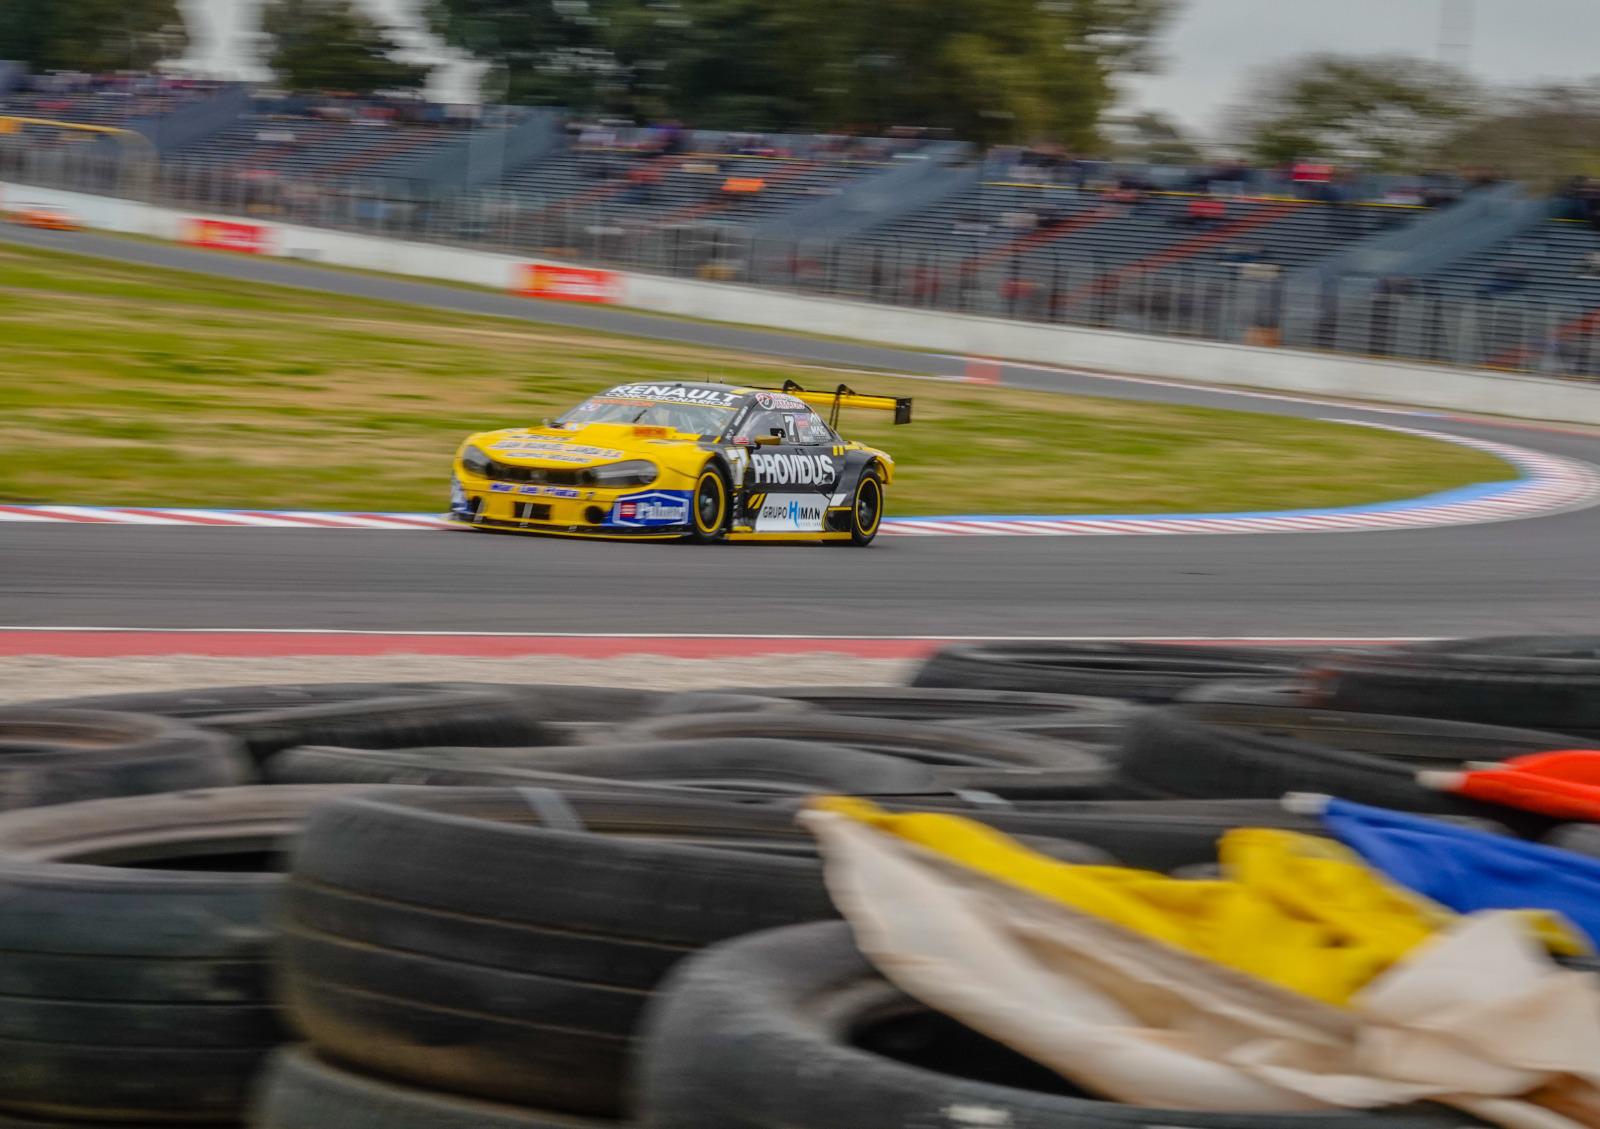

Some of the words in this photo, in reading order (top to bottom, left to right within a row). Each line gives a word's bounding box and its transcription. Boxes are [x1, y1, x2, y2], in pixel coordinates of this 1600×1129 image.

[609, 385, 743, 403] RENAULT
[784, 415, 795, 436] 7
[726, 447, 747, 486] 7
[751, 453, 836, 486] PROVIDUS
[763, 506, 787, 519] GRUPO
